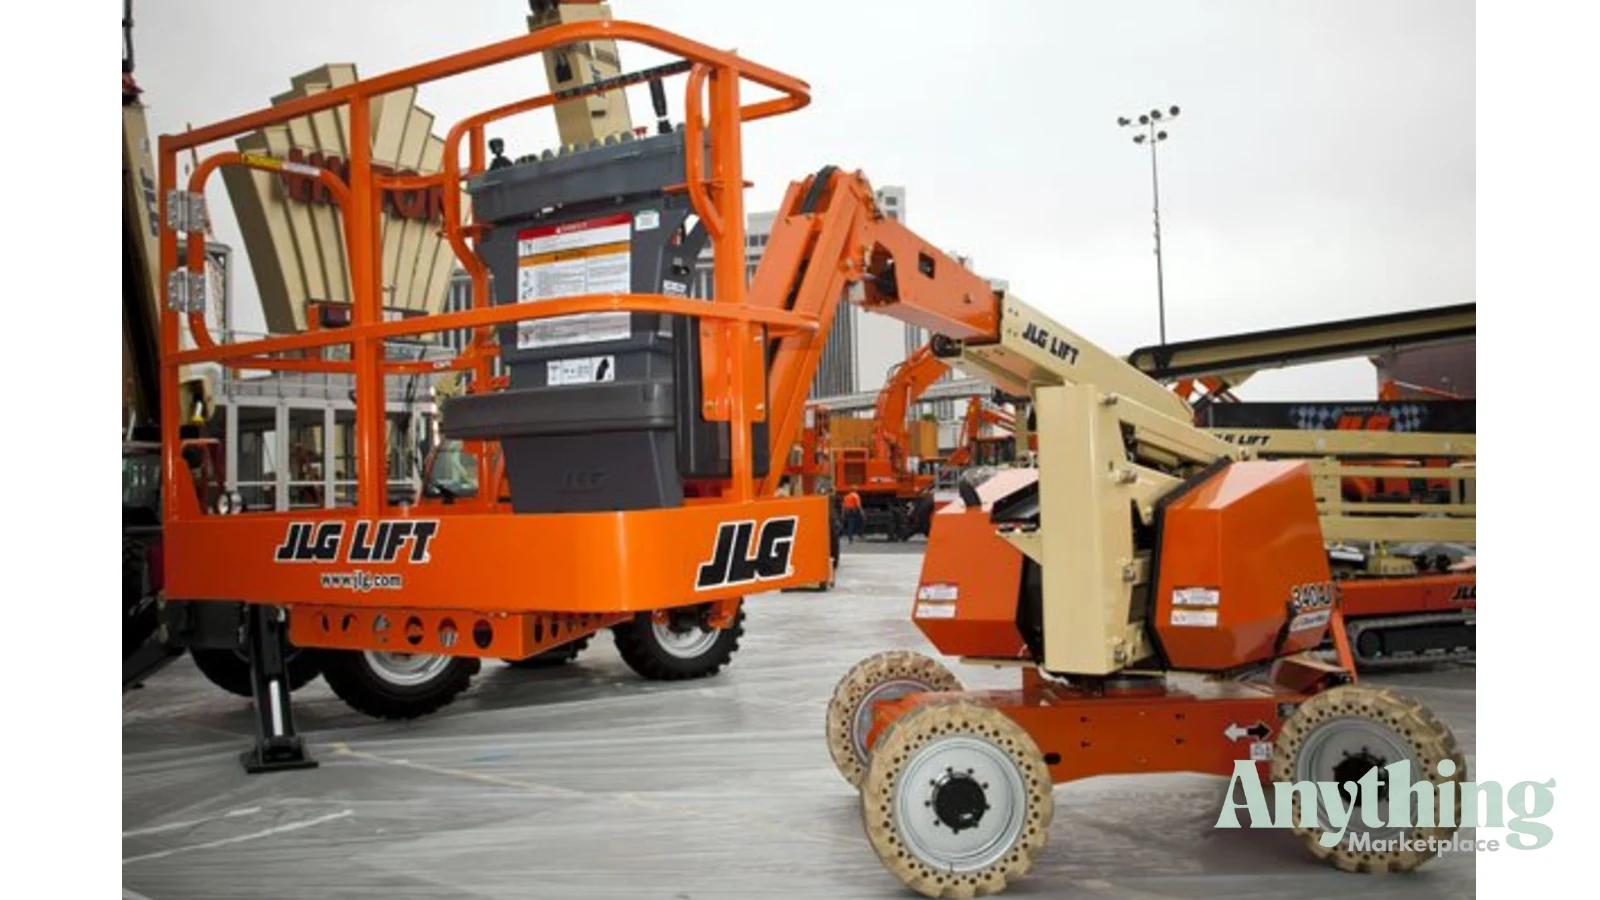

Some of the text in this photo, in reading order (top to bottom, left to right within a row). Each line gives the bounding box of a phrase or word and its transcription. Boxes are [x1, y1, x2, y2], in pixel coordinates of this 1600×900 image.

[1022, 322, 1079, 365] JLG LIFT
[275, 520, 440, 563] JLG LIFT
[695, 516, 799, 591] JLG
[320, 570, 404, 592] www.jlg.com
